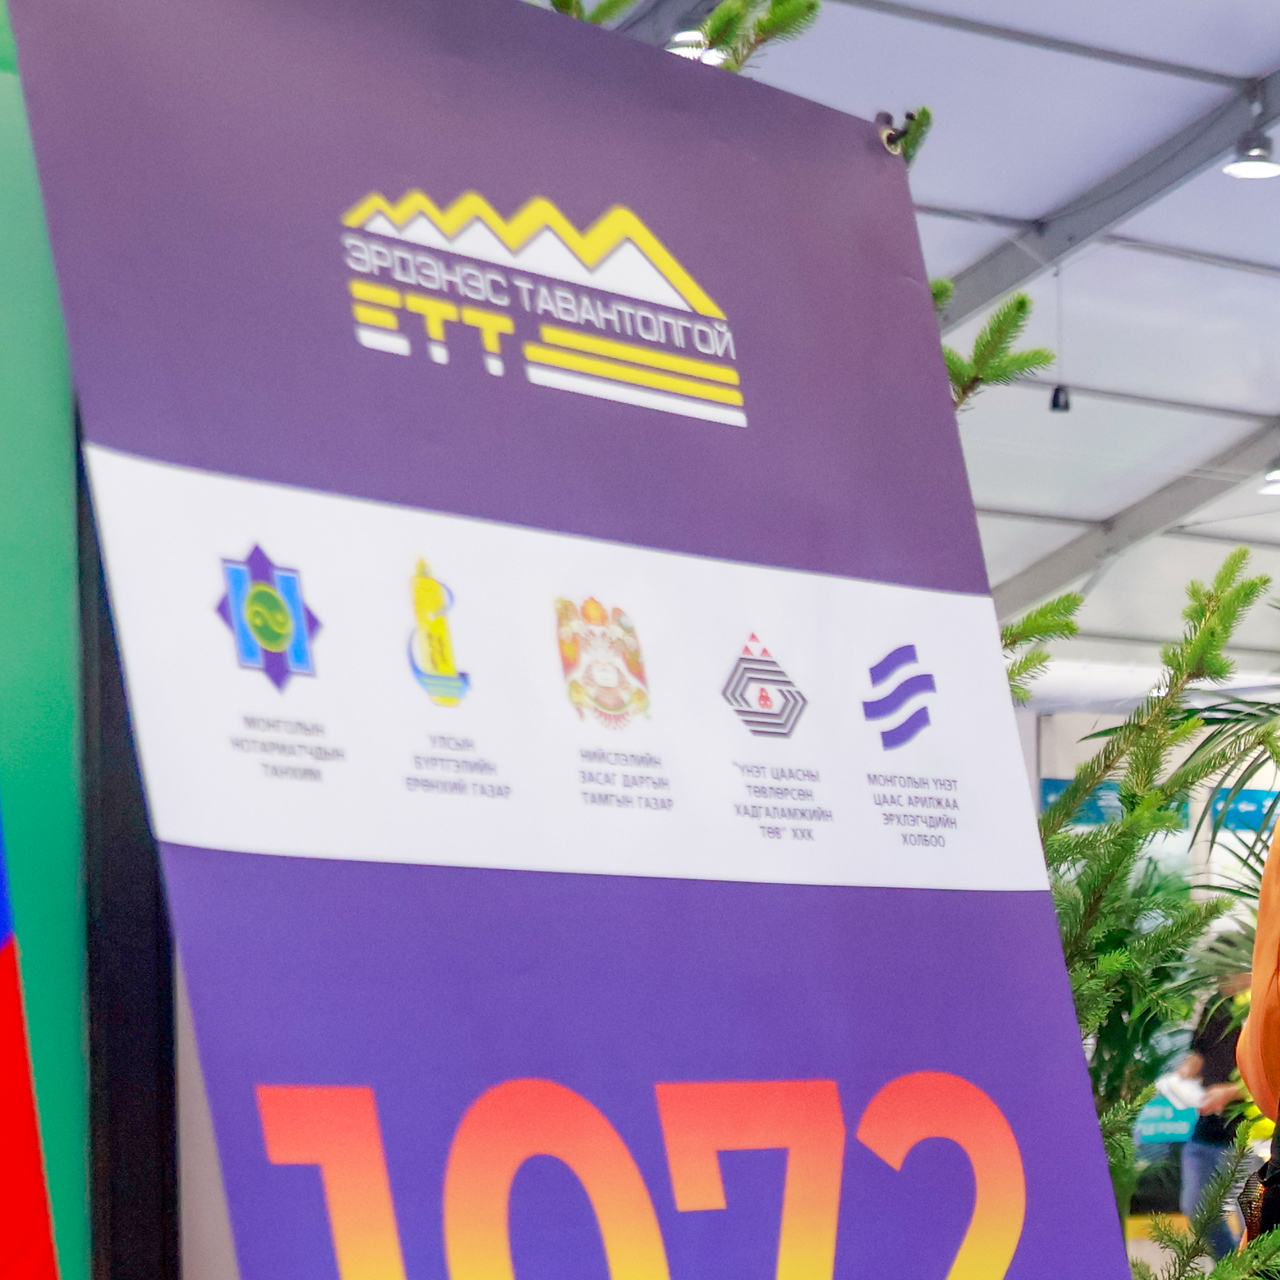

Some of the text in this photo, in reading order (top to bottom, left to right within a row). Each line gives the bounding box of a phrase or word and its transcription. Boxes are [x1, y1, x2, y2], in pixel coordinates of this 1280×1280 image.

[342, 235, 737, 361] ЭРДЭНЭС ТАВАНТОЛГОЙ
[578, 770, 670, 790] ЗАСАГ ДАРГЫН
[770, 766, 821, 783] ЦААСНЫ
[867, 773, 958, 793] МОНГОЛЫН ҮНЭТ
[472, 782, 512, 800] ГАЗАР
[746, 784, 814, 802] ТӨВЛӨРСӨН
[637, 795, 675, 812] ГАЗАР
[873, 793, 960, 811] ЦААС АРИЛЖАА
[733, 803, 834, 823] ХАДГАЛАМЖИЙН
[882, 812, 958, 830] ЭРХЛЭГЧДИЙН
[792, 827, 815, 842] ХХК
[901, 832, 946, 848] ХОЛБОО
